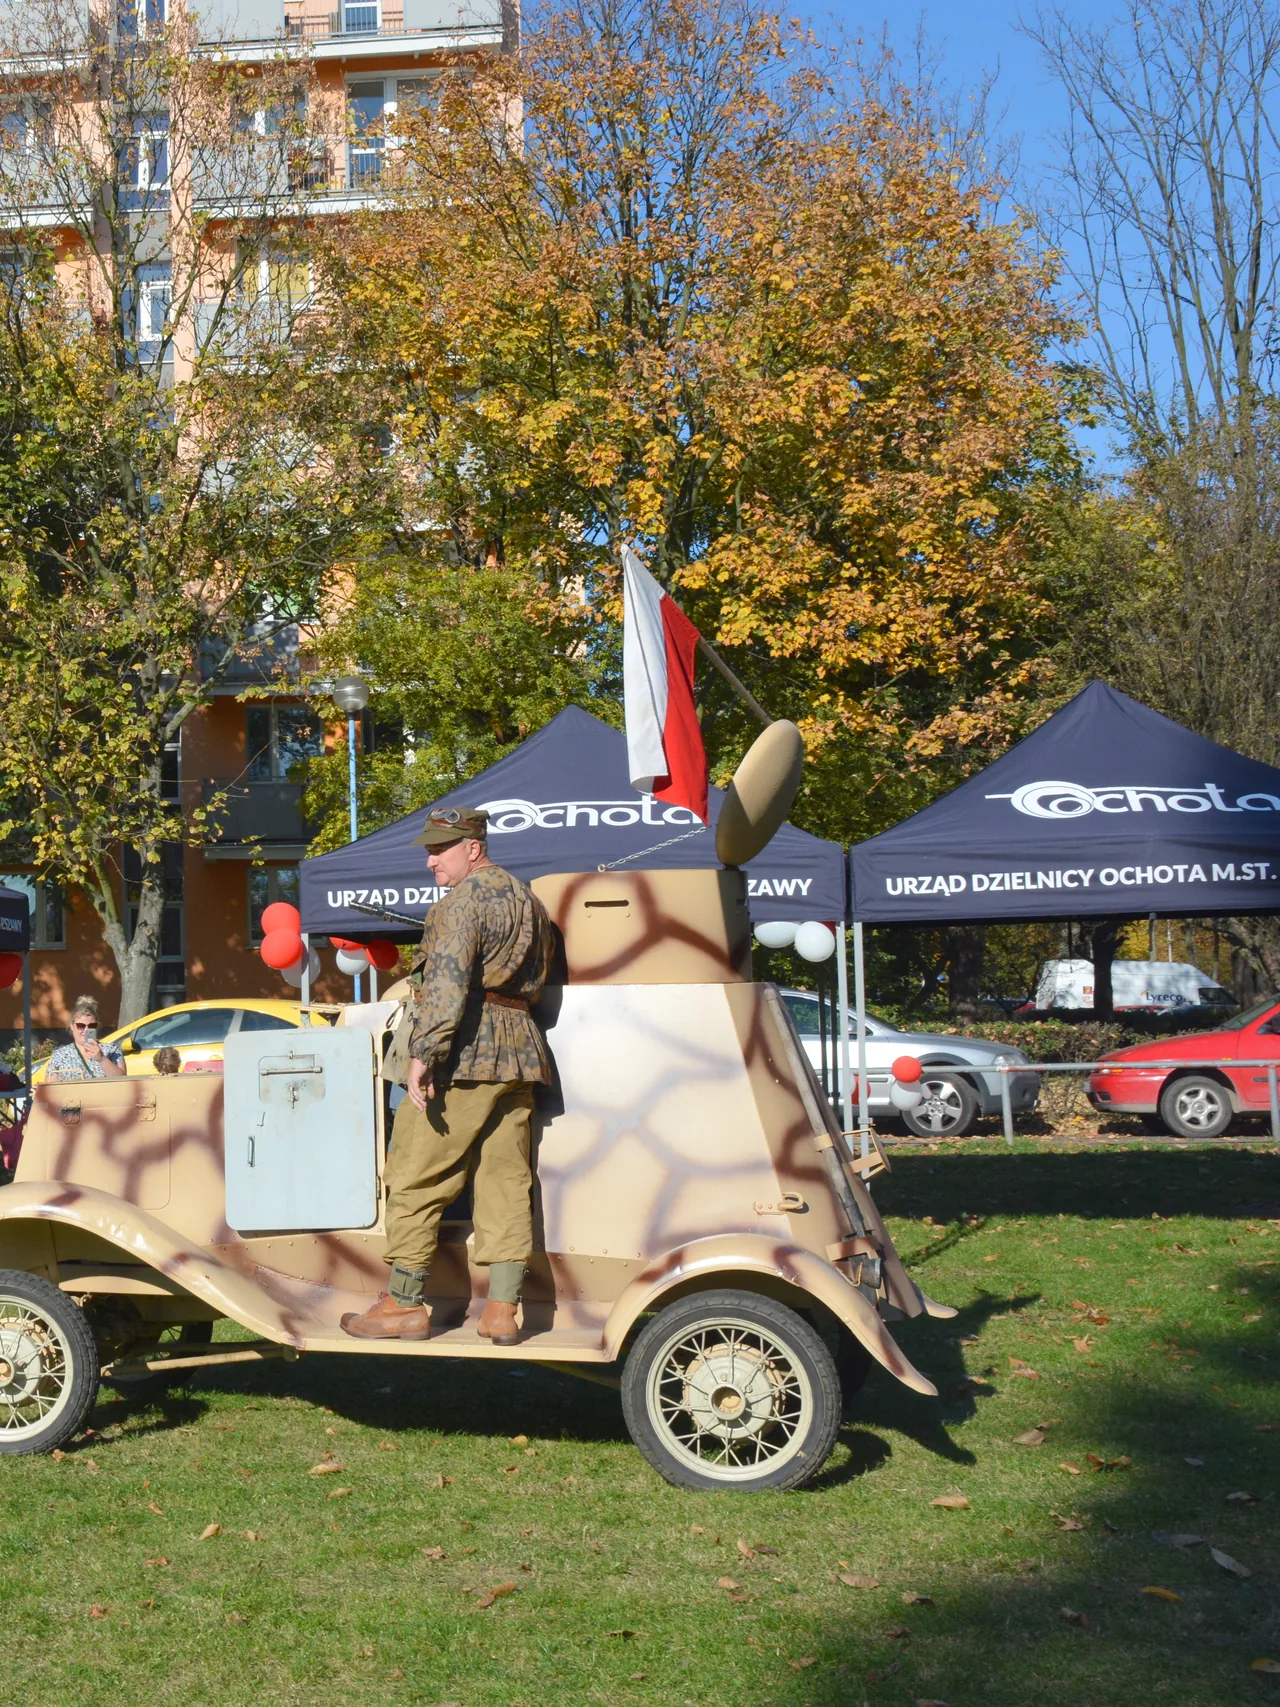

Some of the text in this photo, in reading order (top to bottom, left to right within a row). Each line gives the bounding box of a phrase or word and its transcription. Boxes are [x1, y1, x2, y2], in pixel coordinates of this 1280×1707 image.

[747, 878, 813, 896] ZAWY
[885, 862, 1277, 896] URZĄD DZIELNICY OCHOTA M.ST.
